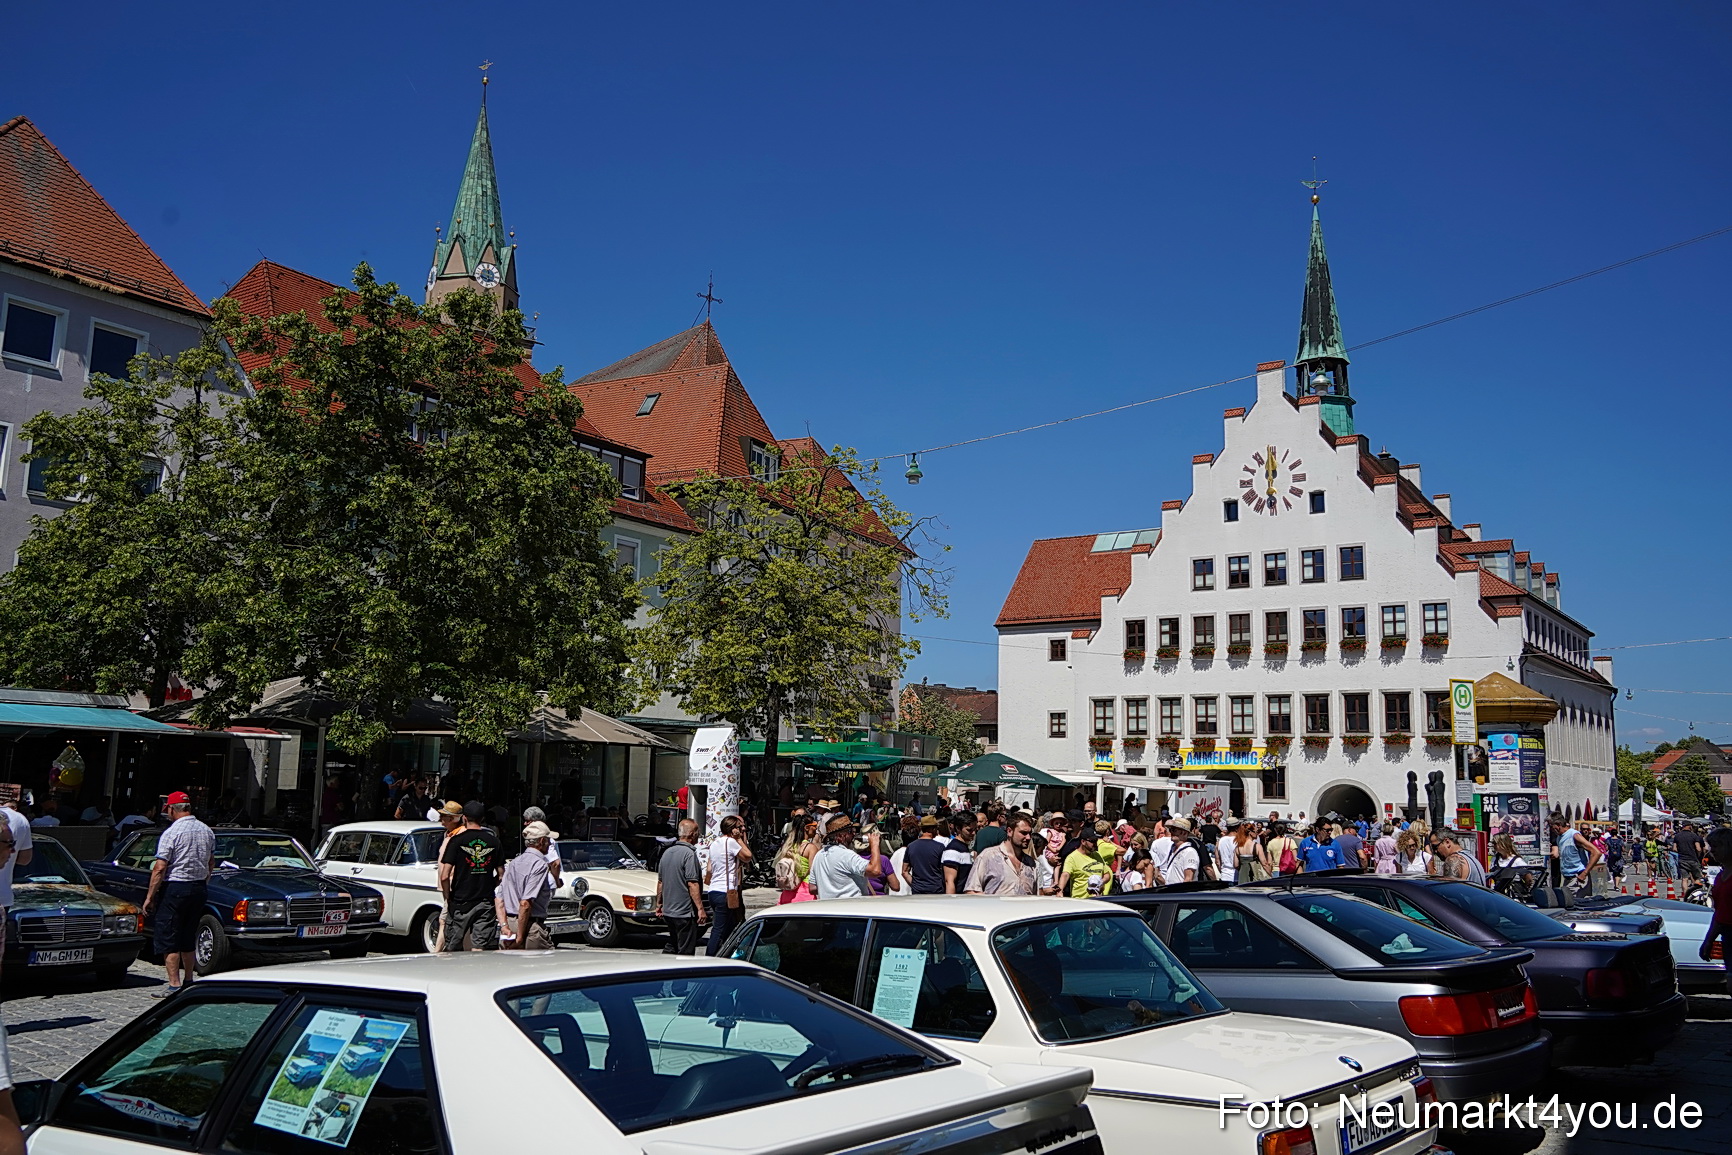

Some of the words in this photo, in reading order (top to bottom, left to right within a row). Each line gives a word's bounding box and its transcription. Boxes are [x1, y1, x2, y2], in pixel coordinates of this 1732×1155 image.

[1095, 750, 1113, 763] WC
[1185, 750, 1258, 766] ANMELDUNG
[307, 926, 319, 935] NM
[36, 951, 51, 962] NM
